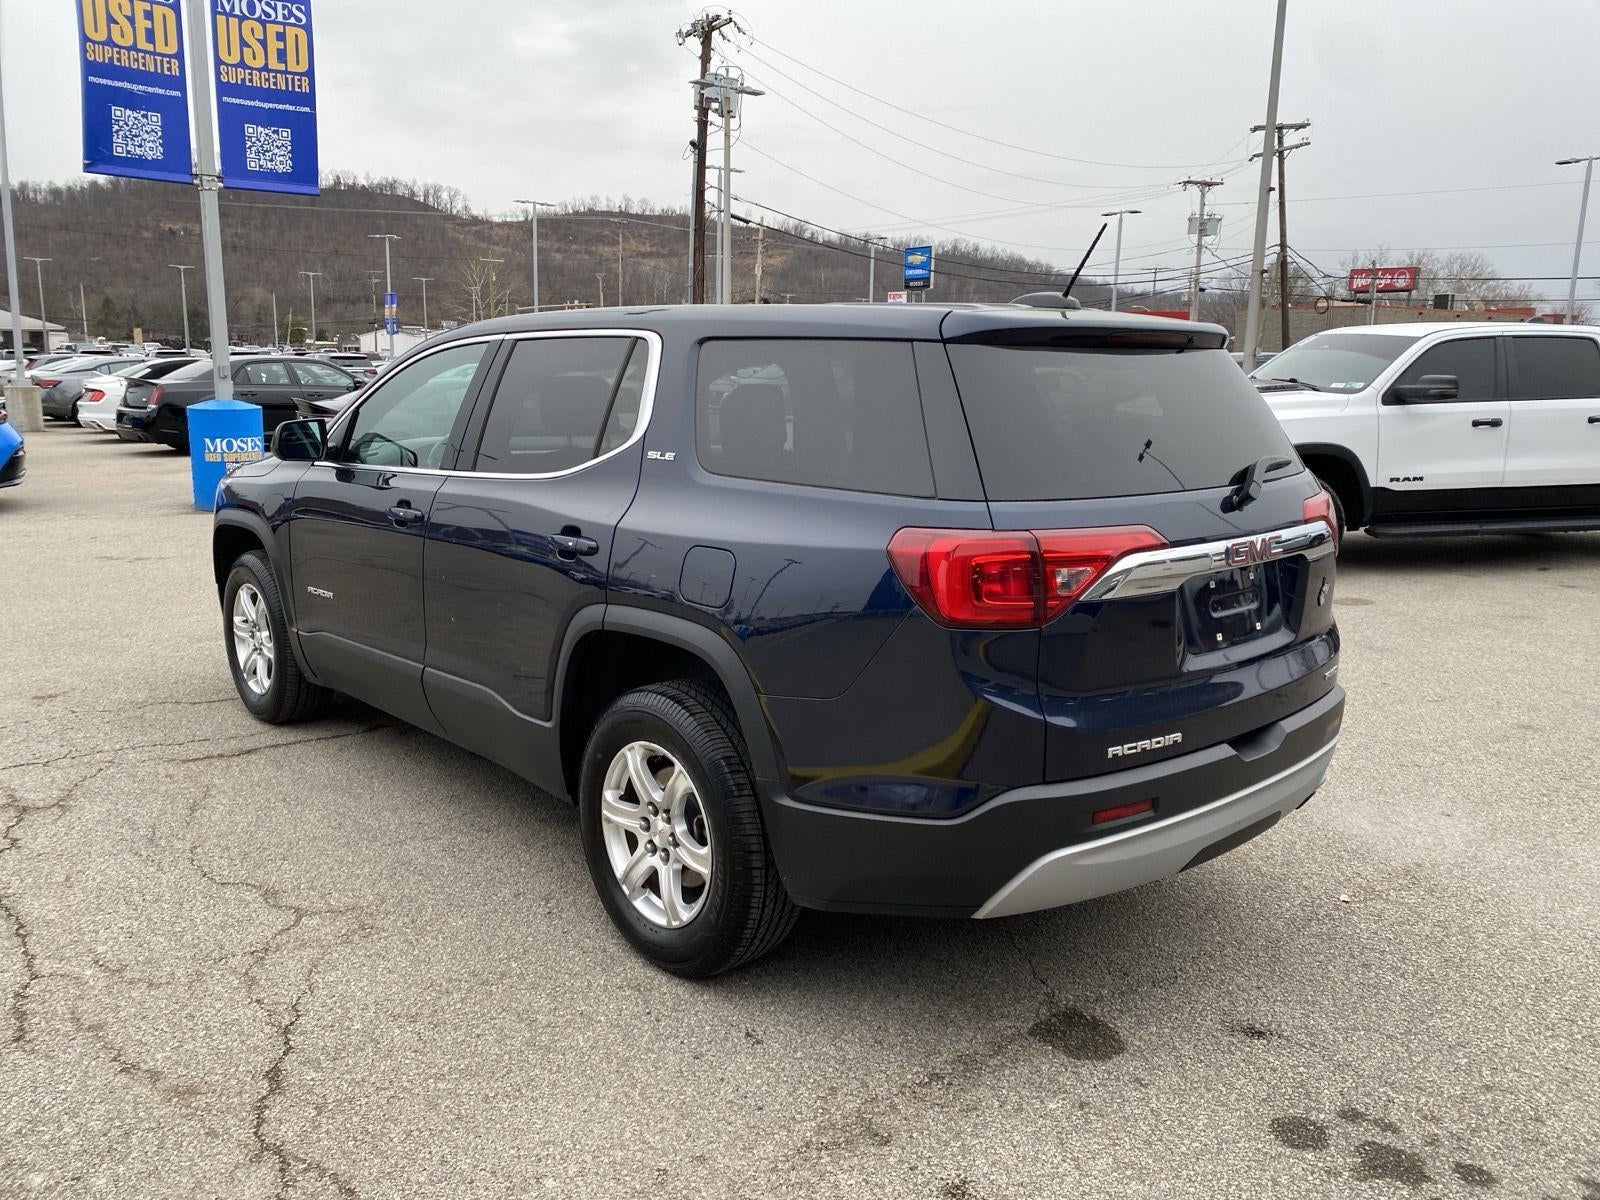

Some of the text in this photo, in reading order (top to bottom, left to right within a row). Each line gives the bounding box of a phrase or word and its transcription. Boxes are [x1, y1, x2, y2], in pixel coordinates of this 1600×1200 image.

[216, 0, 307, 25] MOSES
[82, 0, 178, 54] USED
[216, 15, 309, 72] USED
[86, 42, 180, 76] SUPERCENTER
[88, 75, 181, 97] mosesusedsupercenter.com
[220, 65, 310, 93] SUPERCENTER
[222, 96, 311, 113] mosesusedsupercenter.com
[203, 437, 262, 453] MOSES
[647, 451, 676, 461] SLE
[1228, 535, 1284, 566] GMC
[307, 586, 334, 600] ACADIA
[1107, 732, 1183, 759] ACADIA
